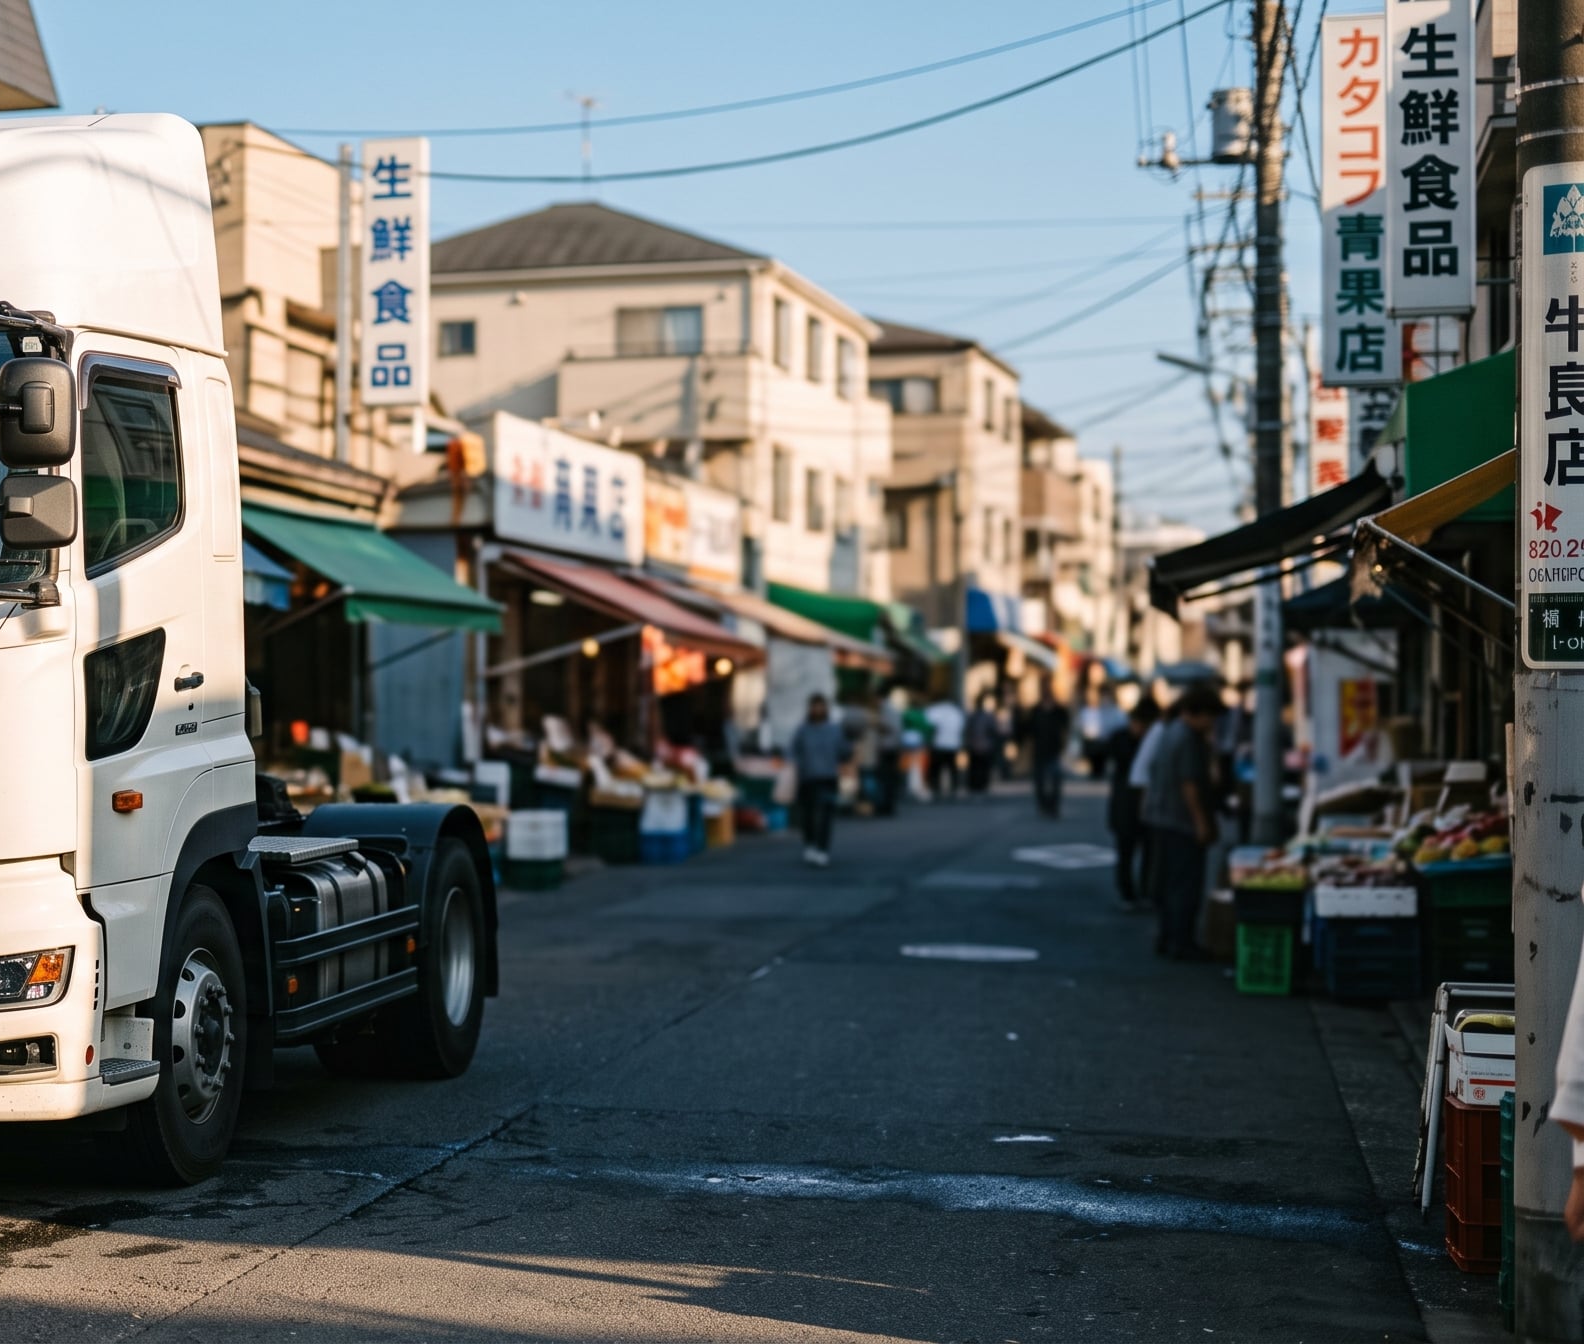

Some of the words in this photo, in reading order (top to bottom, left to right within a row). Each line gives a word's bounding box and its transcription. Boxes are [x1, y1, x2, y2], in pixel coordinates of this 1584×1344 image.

[1399, 23, 1460, 277] 生鮮食品
[370, 155, 414, 387] 生鮮食品
[1529, 539, 1584, 559] 820.2
